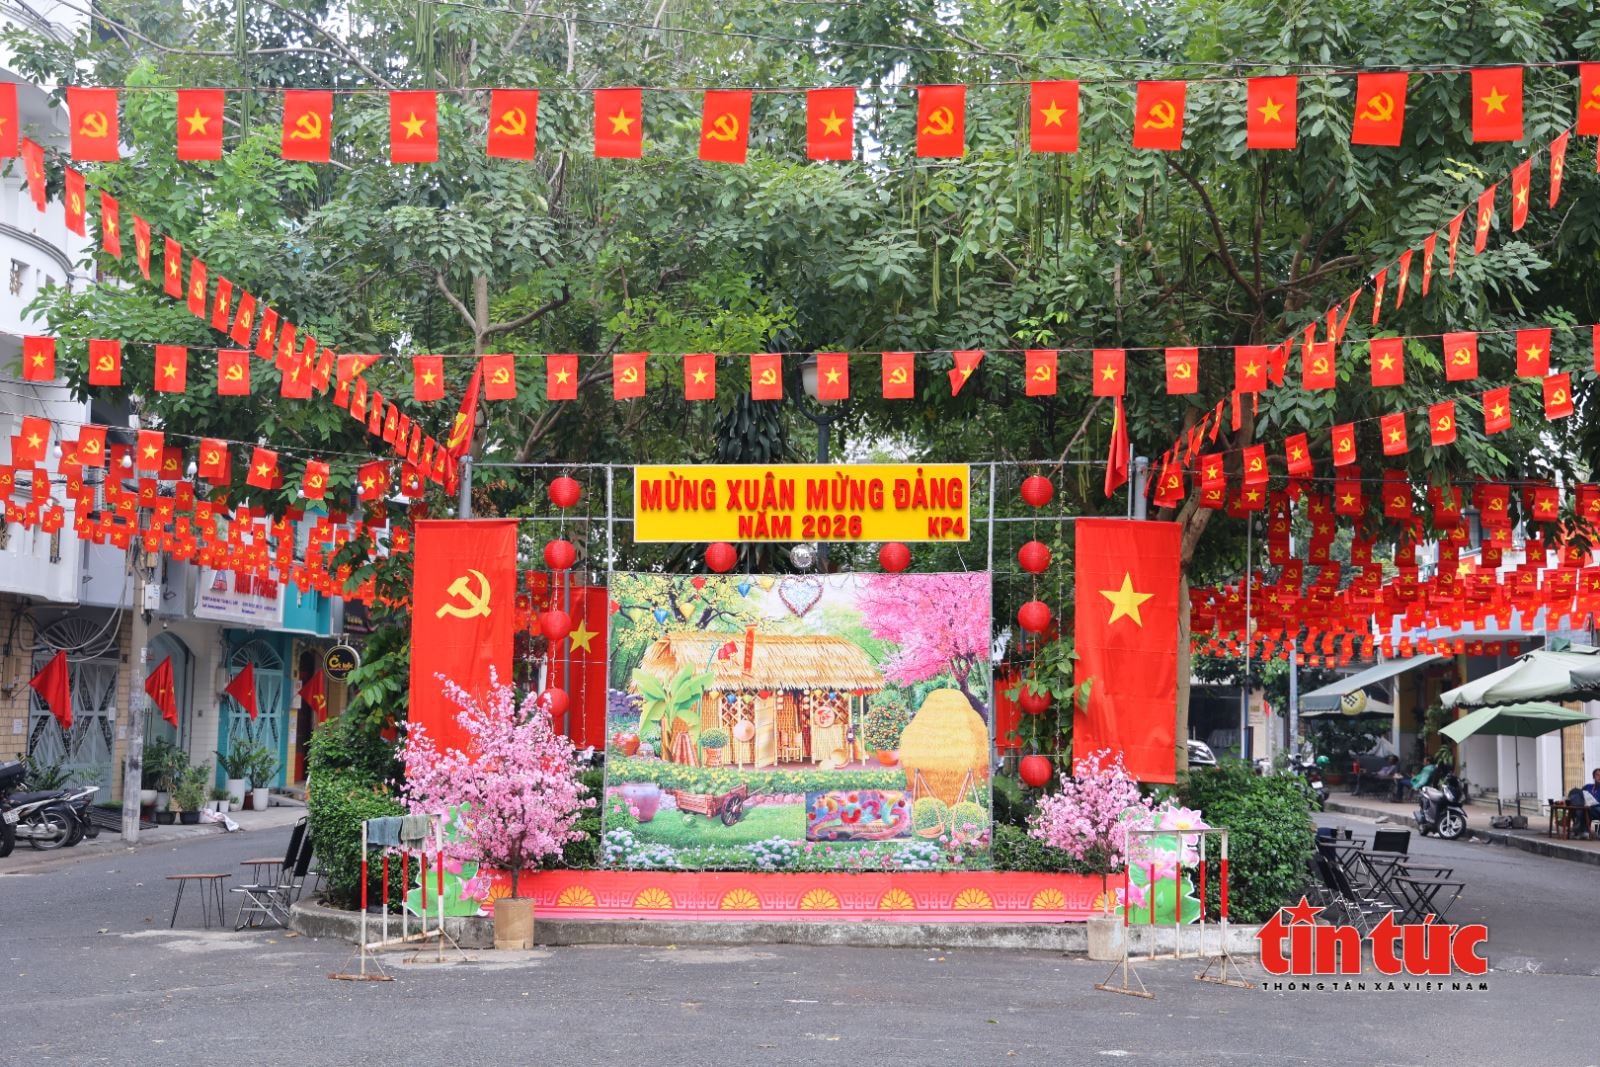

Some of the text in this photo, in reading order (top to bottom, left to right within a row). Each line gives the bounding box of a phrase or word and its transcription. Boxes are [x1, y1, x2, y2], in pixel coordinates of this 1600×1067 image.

[641, 467, 963, 510] MỪNG XUÂN MỪNG ĐẢNG
[738, 511, 863, 539] NĂM 2026
[928, 516, 965, 539] KP4
